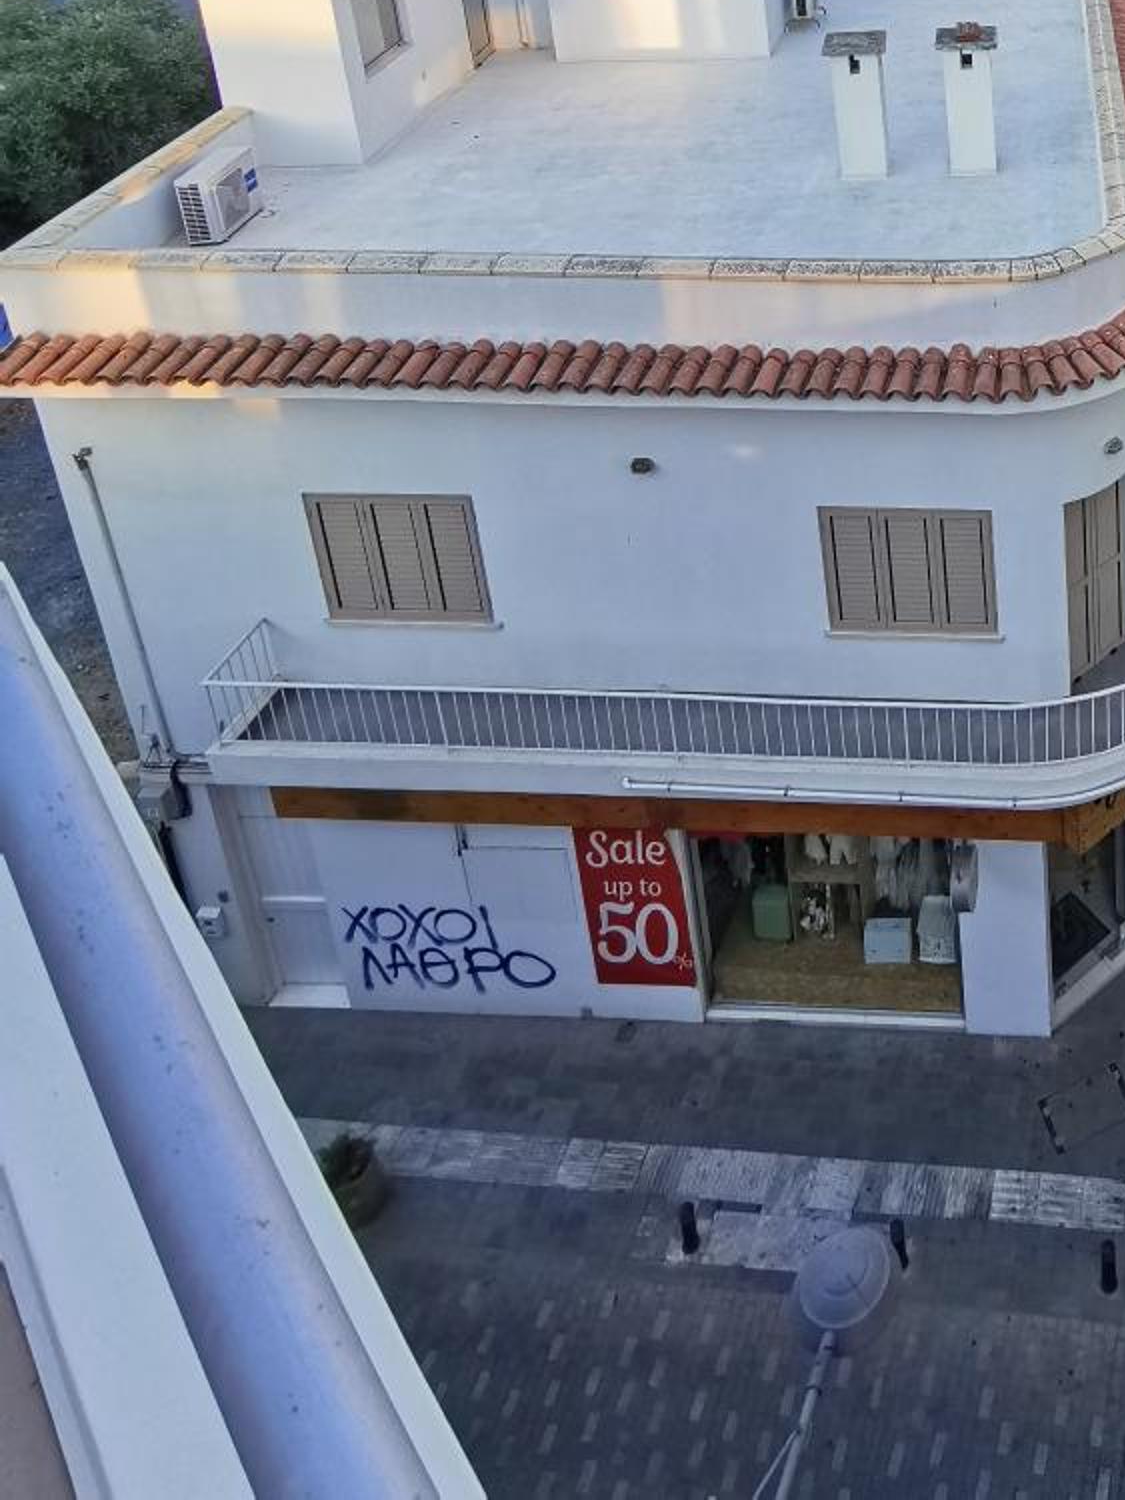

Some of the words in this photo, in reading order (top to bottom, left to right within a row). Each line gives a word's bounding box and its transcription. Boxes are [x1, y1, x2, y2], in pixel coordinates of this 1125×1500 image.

[586, 830, 666, 868] Sale
[604, 880, 633, 901] up
[640, 879, 662, 897] to
